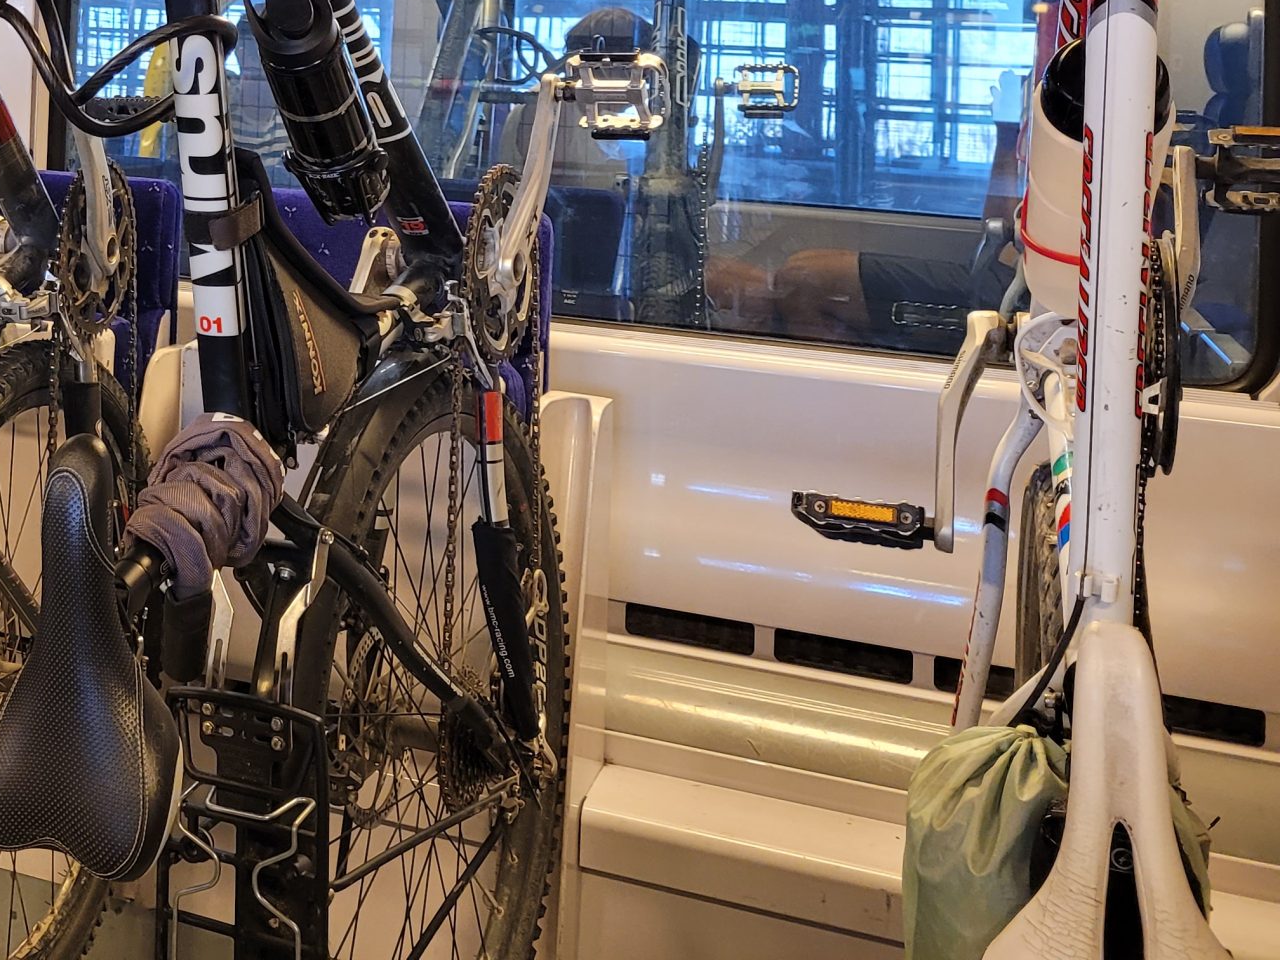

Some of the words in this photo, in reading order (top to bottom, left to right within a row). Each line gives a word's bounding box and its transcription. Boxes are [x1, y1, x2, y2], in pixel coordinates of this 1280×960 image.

[199, 316, 223, 333] 01
[293, 291, 322, 395] KONNIX
[482, 584, 515, 678] www.bmc-racing.com
